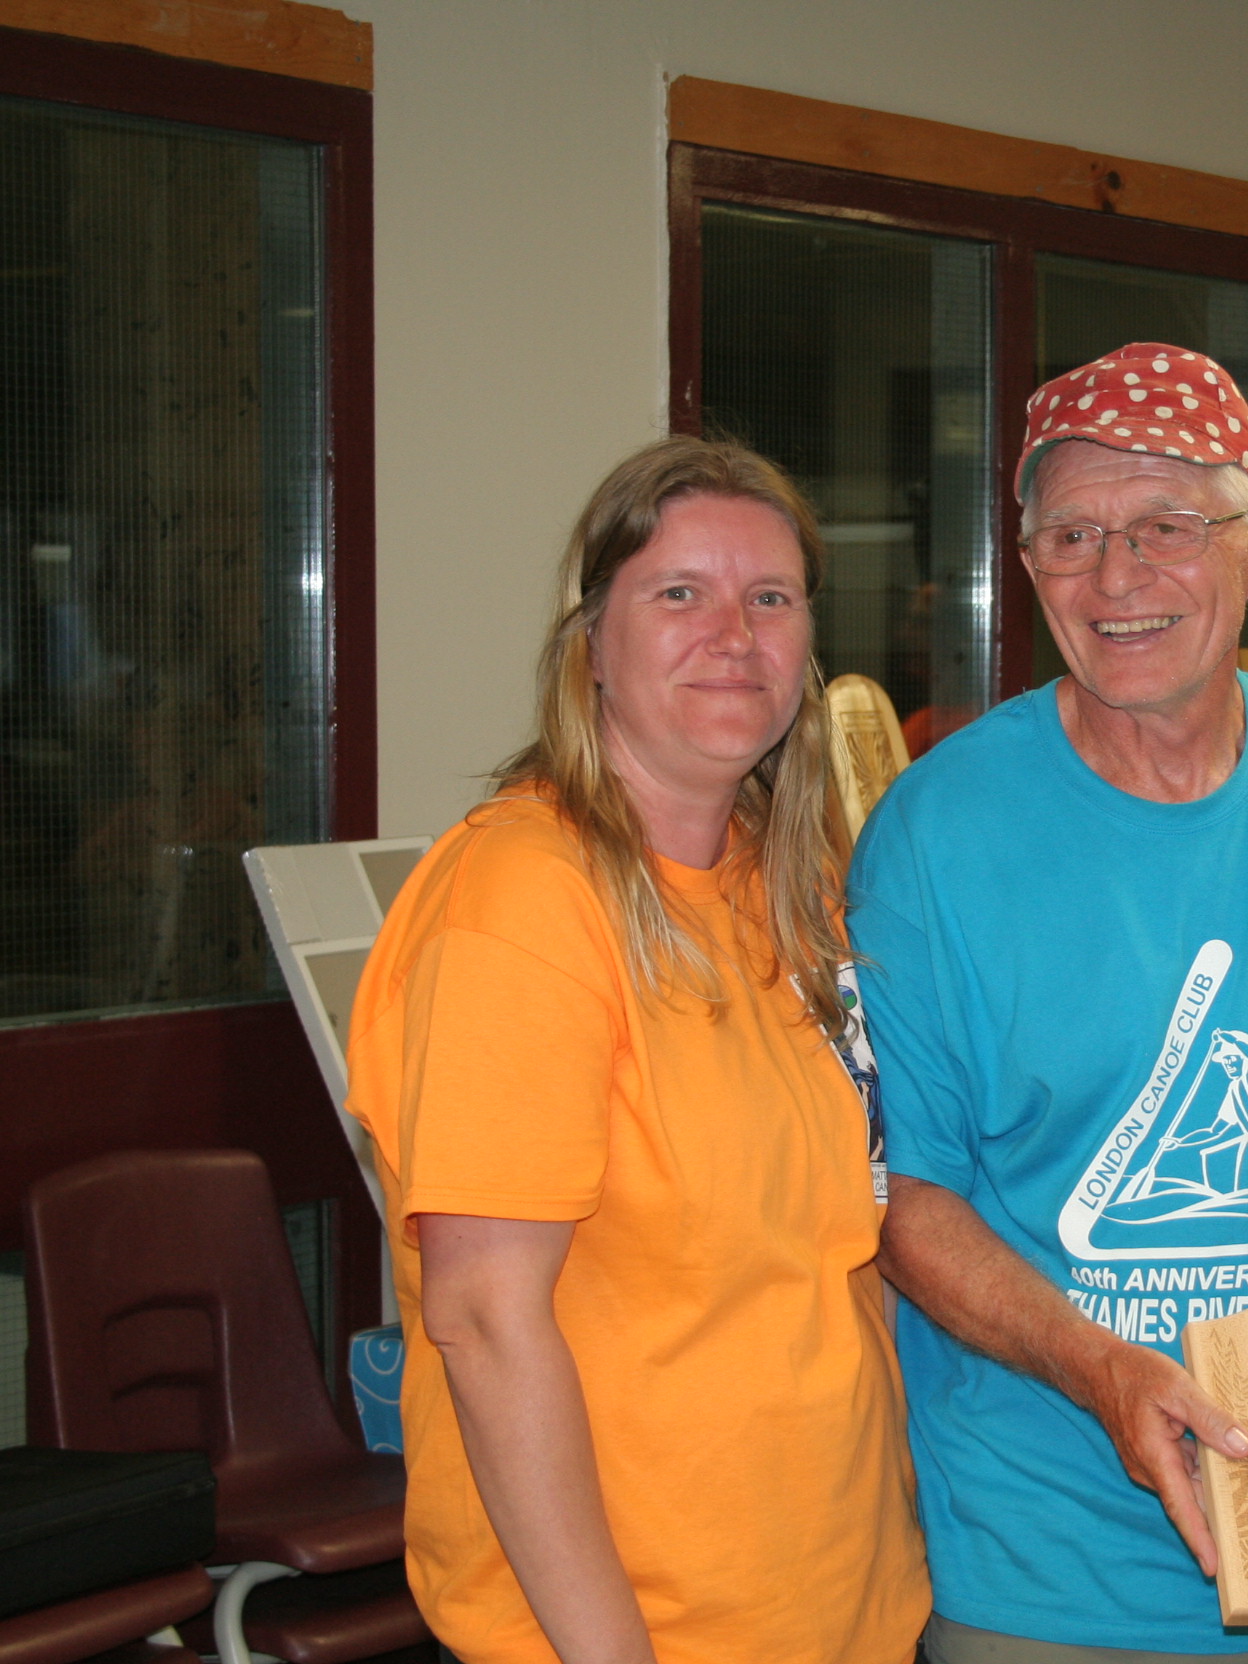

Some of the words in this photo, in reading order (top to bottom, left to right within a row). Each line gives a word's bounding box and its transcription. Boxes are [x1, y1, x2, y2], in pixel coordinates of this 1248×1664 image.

[1078, 1117, 1144, 1210] LONDON
[1141, 1035, 1185, 1114] CANOE
[1177, 972, 1214, 1034] CLUB
